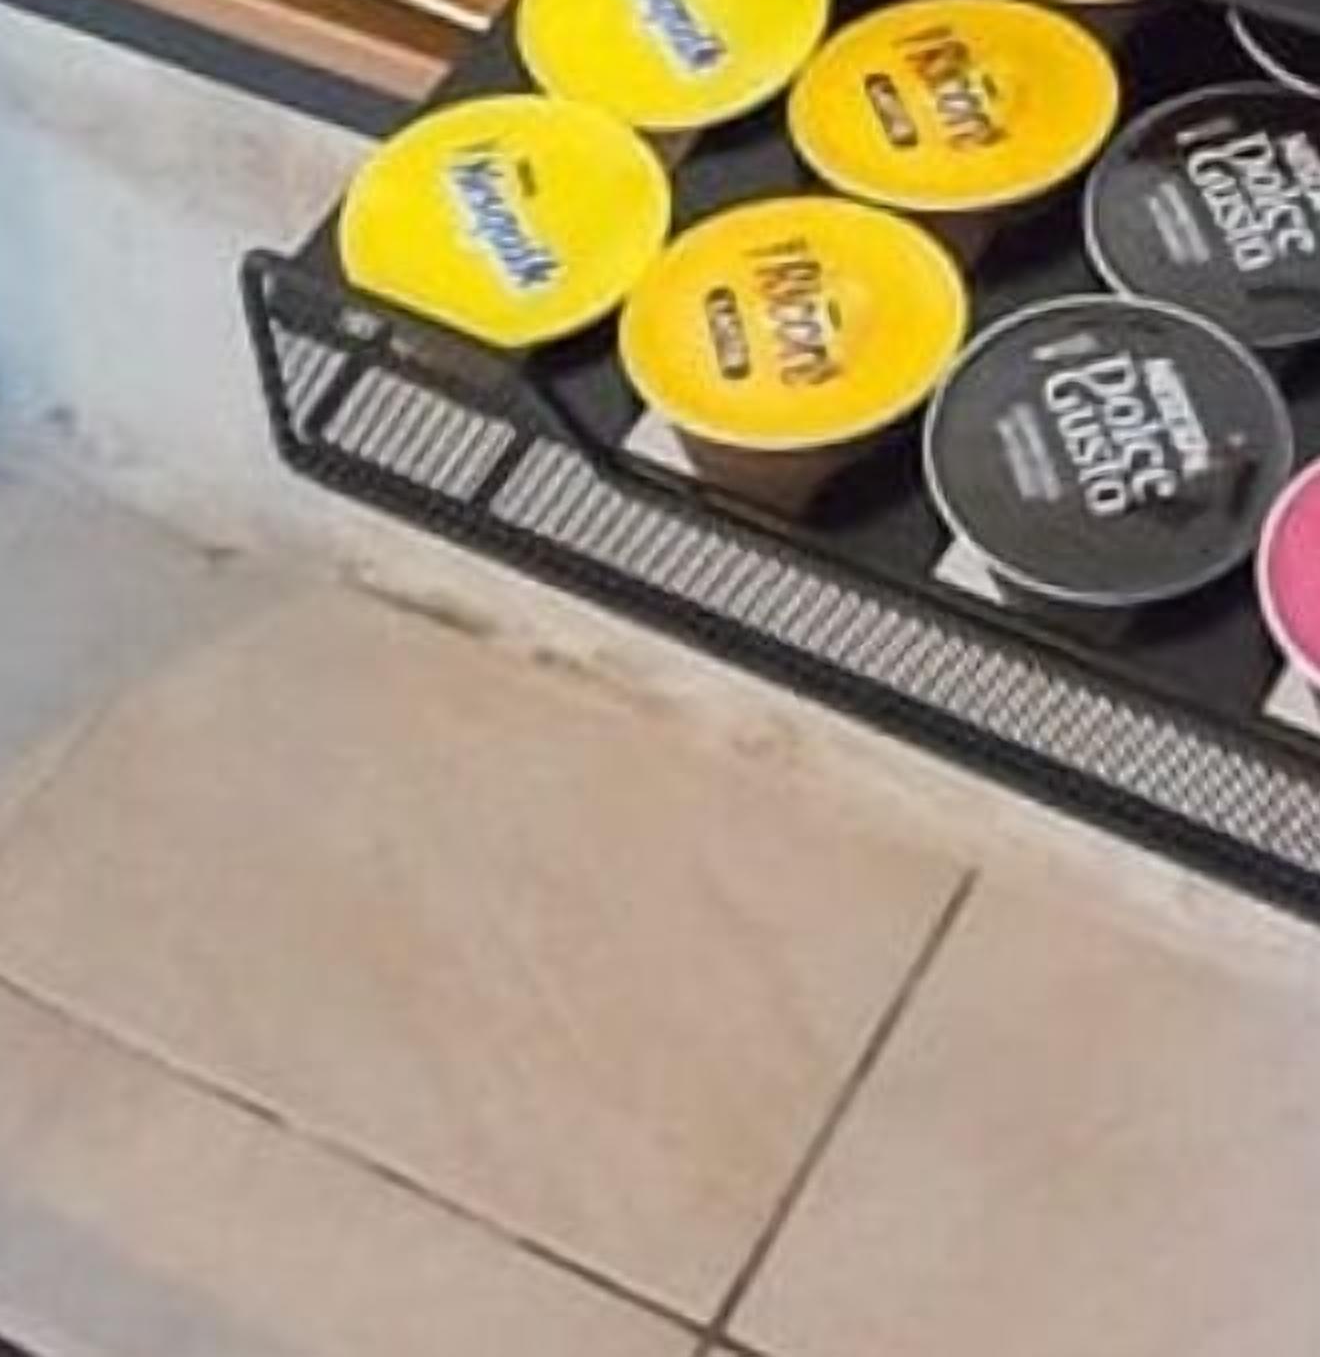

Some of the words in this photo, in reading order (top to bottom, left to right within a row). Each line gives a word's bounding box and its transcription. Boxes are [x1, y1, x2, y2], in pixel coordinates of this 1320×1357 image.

[1187, 149, 1277, 271] Gusto
[1226, 131, 1316, 259] Dolce
[1045, 370, 1128, 516] Gusto
[1082, 350, 1178, 504] Dolce
